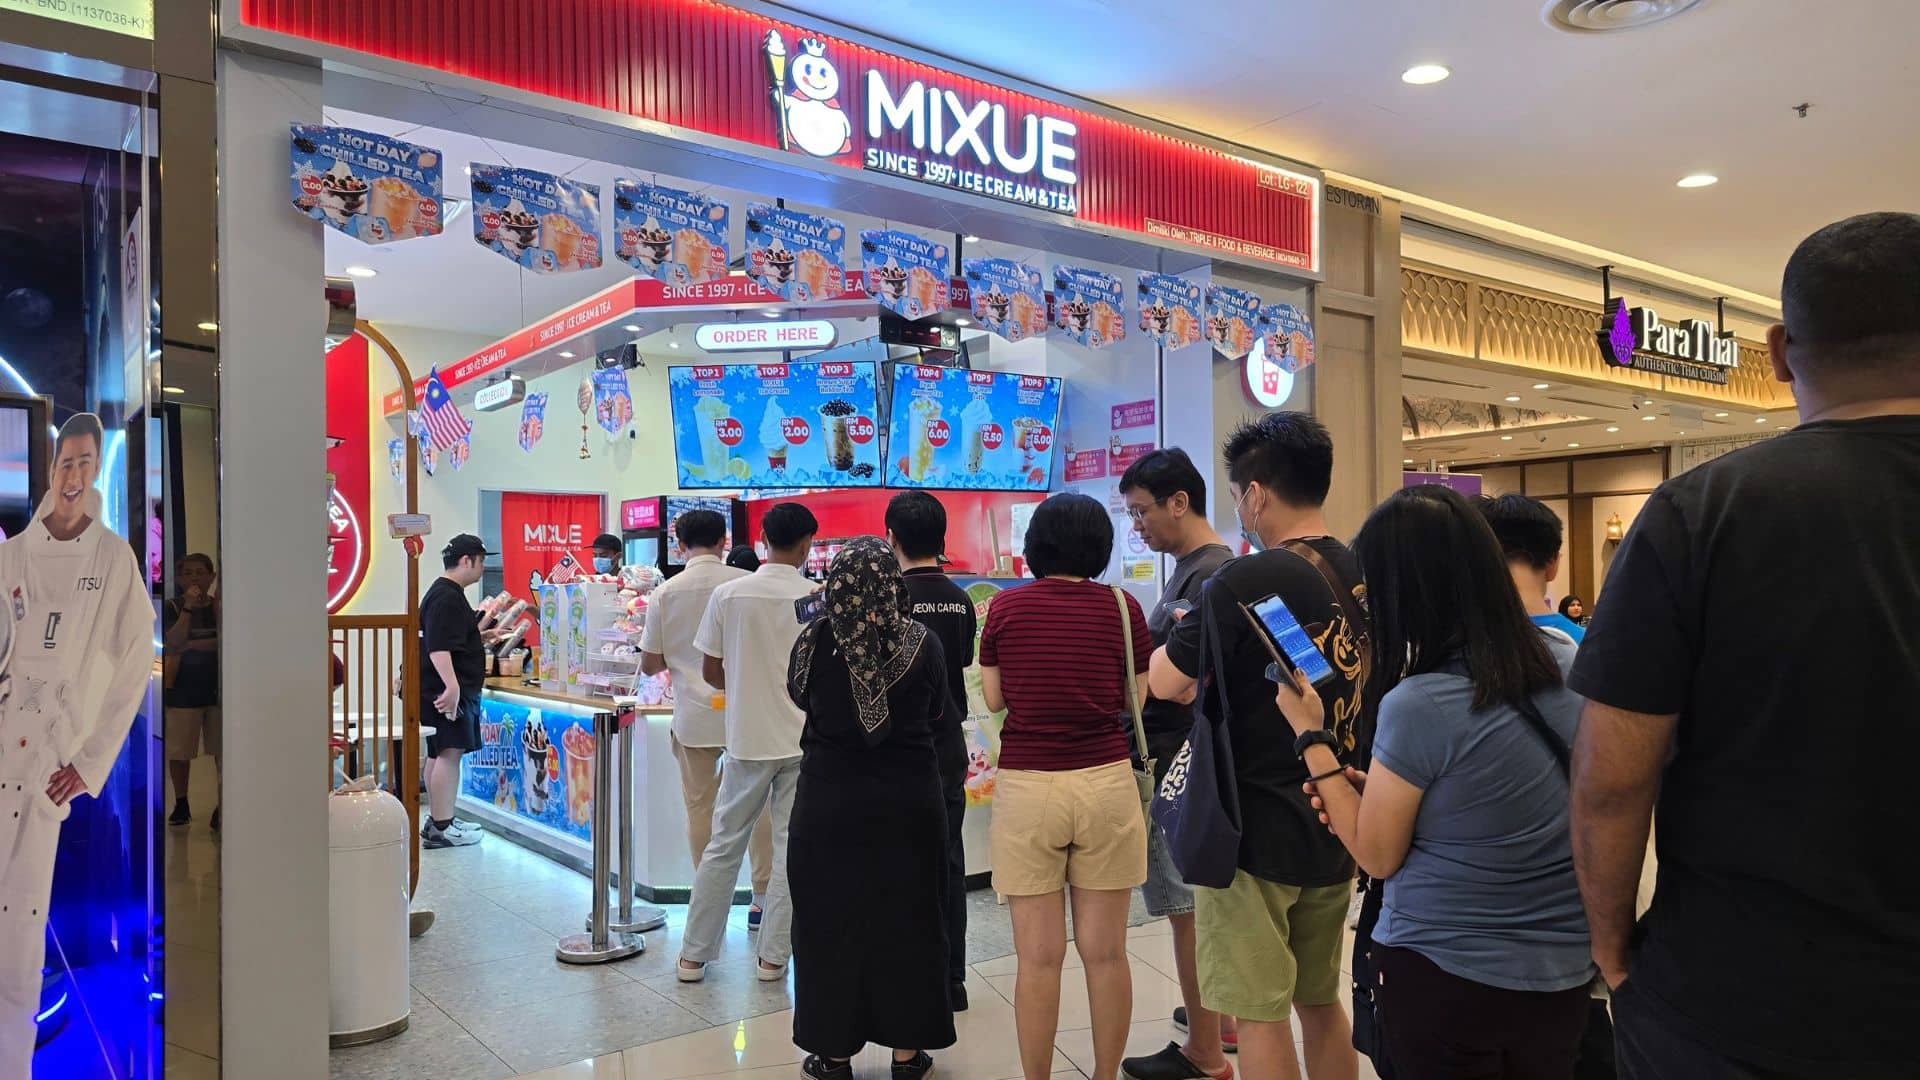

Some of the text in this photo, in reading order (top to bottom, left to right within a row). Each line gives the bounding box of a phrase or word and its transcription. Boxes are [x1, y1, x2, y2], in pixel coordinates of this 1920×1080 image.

[868, 69, 1077, 185] MIXUE
[338, 133, 411, 162] HOT DAY
[320, 144, 425, 183] CHILLED TEA
[867, 148, 918, 176] SINCE
[302, 180, 322, 190] 5.00
[512, 174, 542, 191] HOT
[1296, 181, 1308, 195] 122
[497, 185, 557, 209] CHILLED
[650, 192, 705, 217] HOT DAY
[1326, 185, 1380, 214] ESTORAN
[418, 203, 437, 213] 6.00
[635, 202, 715, 234] CHILLED TEA
[775, 214, 823, 238] HOT DAY
[763, 224, 833, 254] CHILLED TEA
[888, 235, 930, 256] HOT DAY
[1189, 231, 1211, 246] TRIPLE
[1217, 237, 1236, 251] FOOD
[1243, 244, 1276, 260] BEVERAGE
[879, 244, 939, 270] CHILLED TEA
[991, 264, 1010, 275] HOT
[845, 278, 864, 292] EA
[982, 272, 1019, 289] CHILLED
[1094, 279, 1111, 291] DAY
[1157, 278, 1188, 296] HOT DAY
[663, 282, 766, 299] SINCE 1997 ICE
[951, 287, 969, 300] 997
[1068, 282, 1117, 304] CHILLED TEA
[1150, 286, 1193, 308] CHILLED TEA
[1231, 296, 1246, 307] DAY
[540, 327, 555, 342] SINCE
[567, 317, 576, 331] ICE
[576, 310, 595, 328] CREAM
[600, 301, 612, 314] TEA
[1237, 308, 1250, 320] TEA
[1275, 308, 1289, 319] HOT
[1269, 316, 1296, 329] CHILLED
[713, 327, 818, 344] ORDER HERE
[1642, 307, 1738, 368] Para Thai
[1634, 355, 1680, 375] AUTHENTIC
[1680, 364, 1698, 379] THAI
[781, 418, 794, 426] RM
[848, 425, 874, 436] 5.50
[927, 420, 939, 429] RM
[718, 427, 742, 438] 3.00
[784, 426, 809, 437] 2.00
[928, 429, 949, 439] 6.00
[983, 432, 1002, 443] 5.50
[1033, 435, 1052, 445] 5.00
[328, 500, 350, 534] EA
[524, 523, 582, 544] MIXUE
[77, 577, 103, 591] ITSU
[938, 602, 967, 615] CARDS
[483, 723, 501, 744] DAY
[501, 746, 519, 768] TEA
